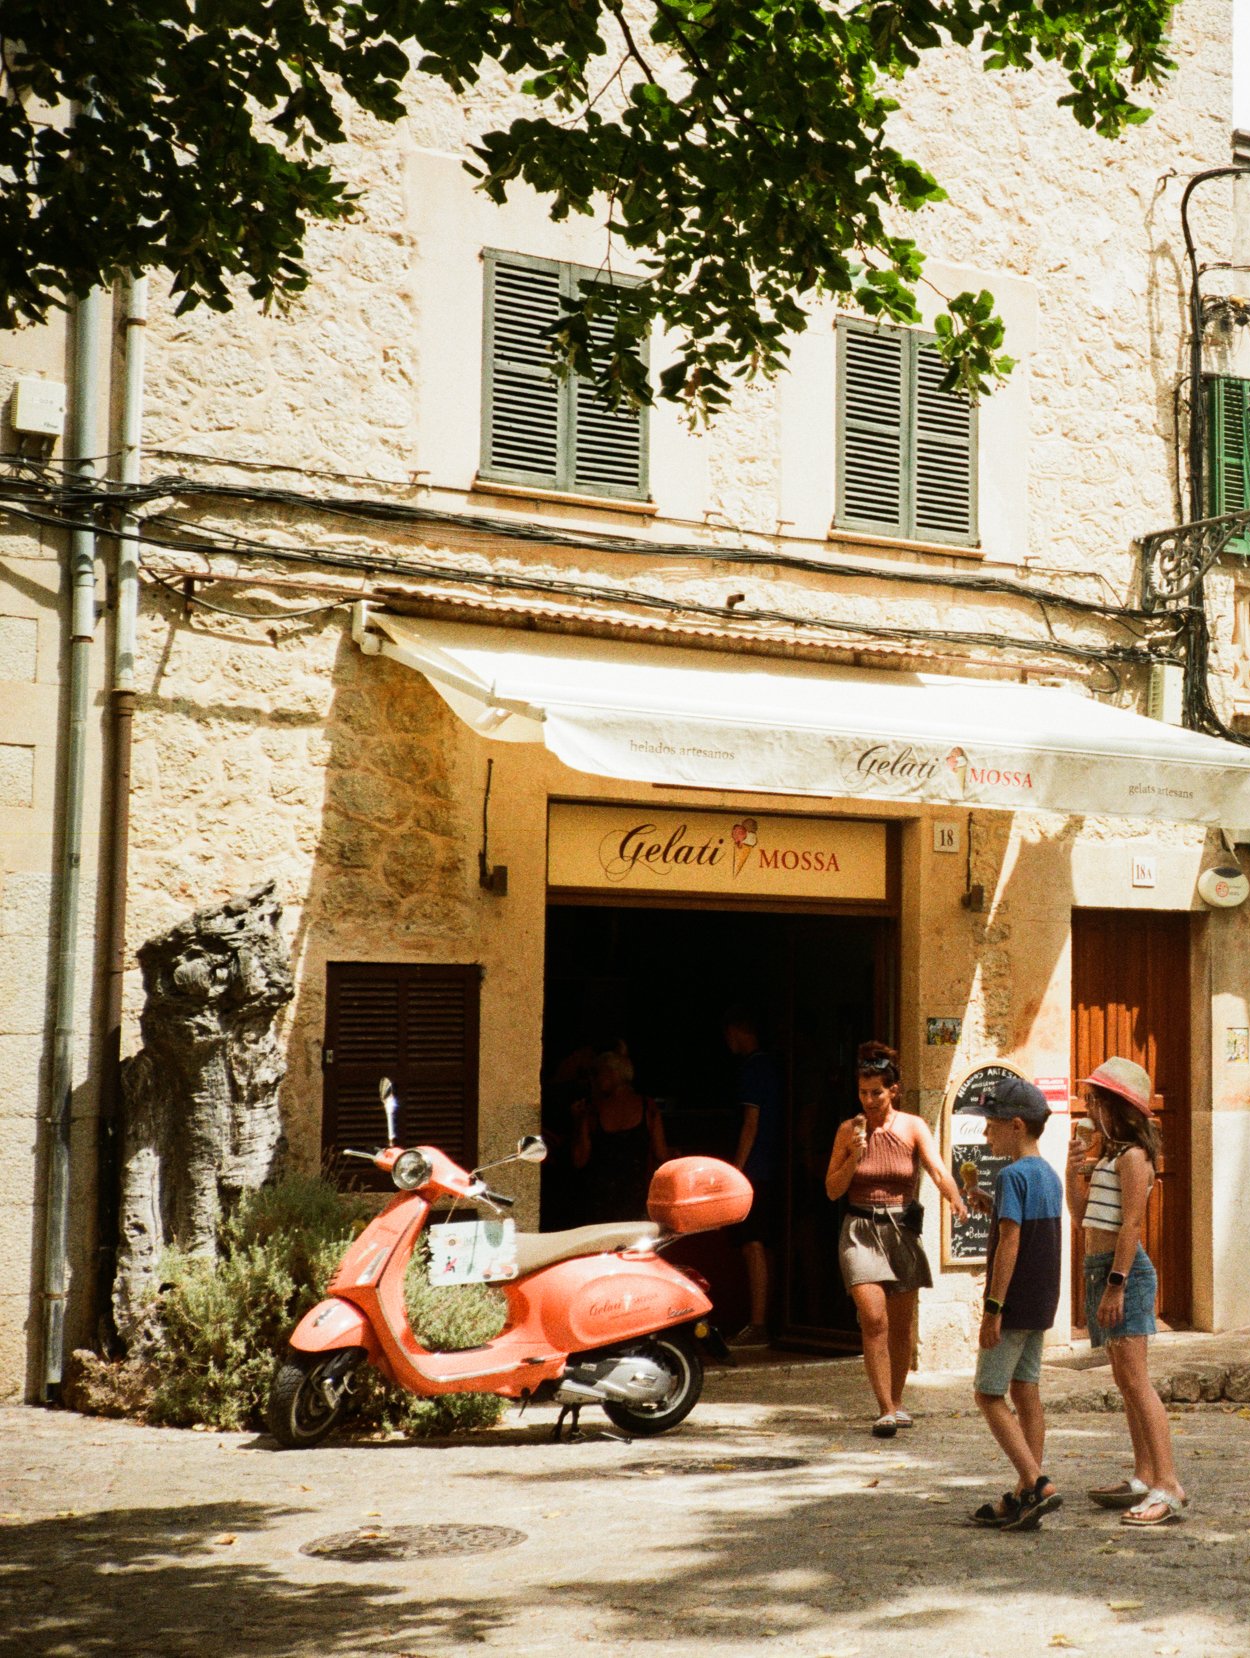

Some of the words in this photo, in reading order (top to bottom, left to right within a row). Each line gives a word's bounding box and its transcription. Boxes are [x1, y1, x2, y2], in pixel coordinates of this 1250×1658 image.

[629, 739, 677, 755] helados
[679, 746, 736, 761] artesanos
[842, 745, 940, 788] Gelati
[968, 767, 1034, 789] MOSSA
[1128, 782, 1156, 796] gelats
[1157, 786, 1194, 799] artesans
[940, 829, 954, 847] 18
[599, 823, 727, 882] Gelati
[759, 848, 841, 872] MOSSA
